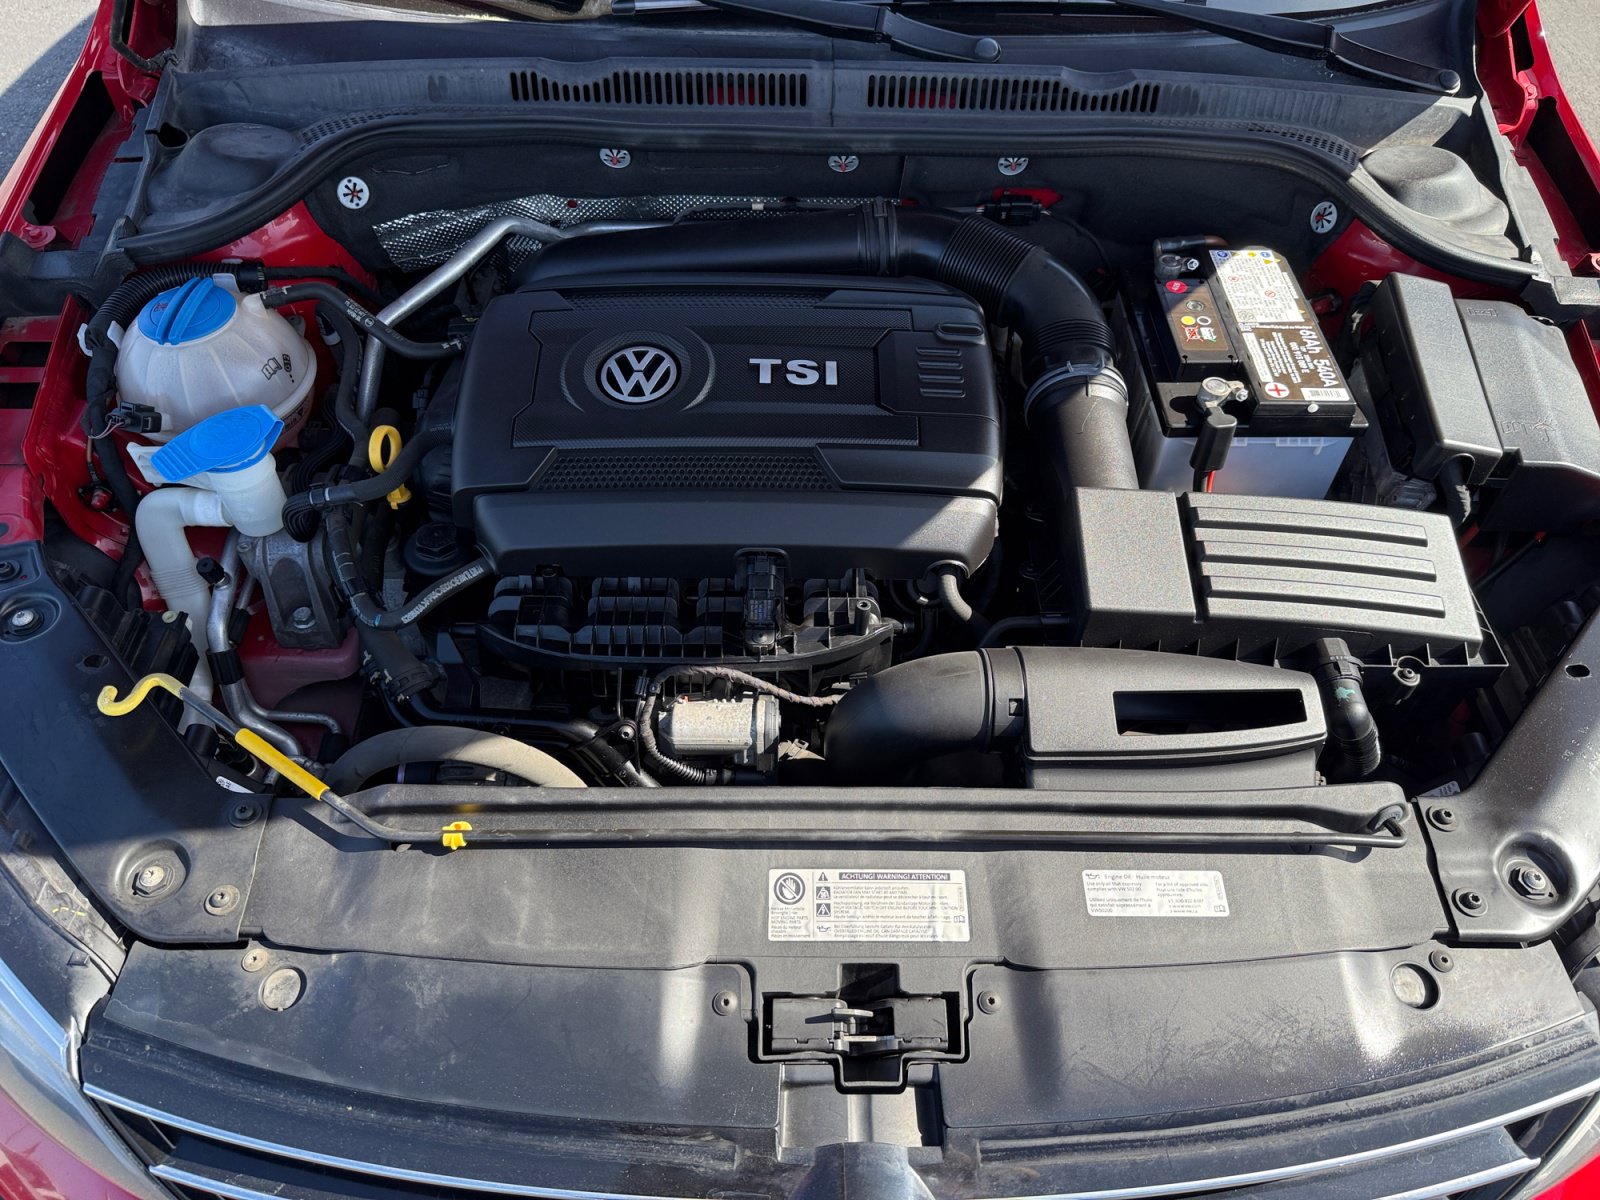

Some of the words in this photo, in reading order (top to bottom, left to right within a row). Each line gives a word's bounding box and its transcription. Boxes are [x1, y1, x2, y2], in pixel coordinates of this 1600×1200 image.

[601, 346, 677, 403] VW
[749, 358, 838, 386] TSI
[1299, 329, 1323, 353] 61Ah
[1313, 359, 1340, 387] 540A
